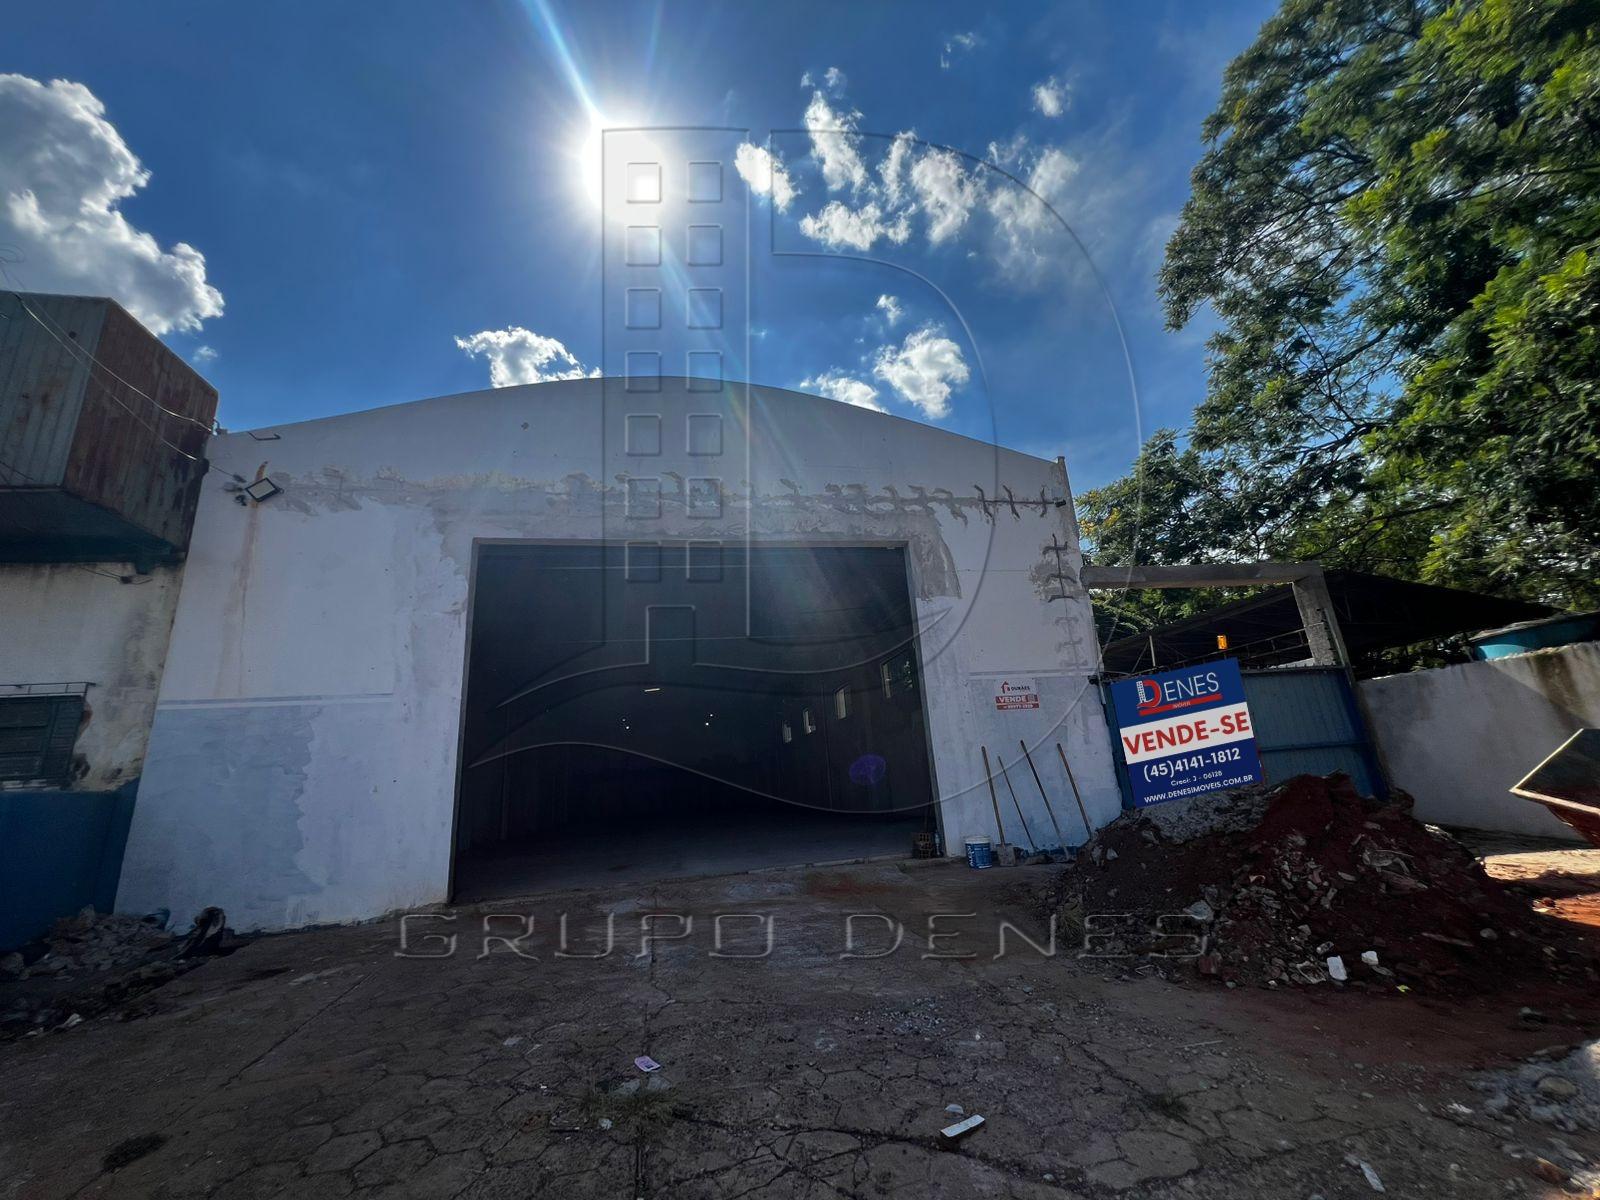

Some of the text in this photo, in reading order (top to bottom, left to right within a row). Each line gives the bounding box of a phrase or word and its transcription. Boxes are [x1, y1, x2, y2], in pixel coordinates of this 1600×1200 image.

[998, 695, 1026, 703] VENDE
[1136, 672, 1219, 708] DENES
[1123, 711, 1250, 756] VENDE-SE
[1143, 748, 1241, 783] (45)4141-1812
[1144, 774, 1253, 804] WWW.DENESIMOVEIS.COM.BR
